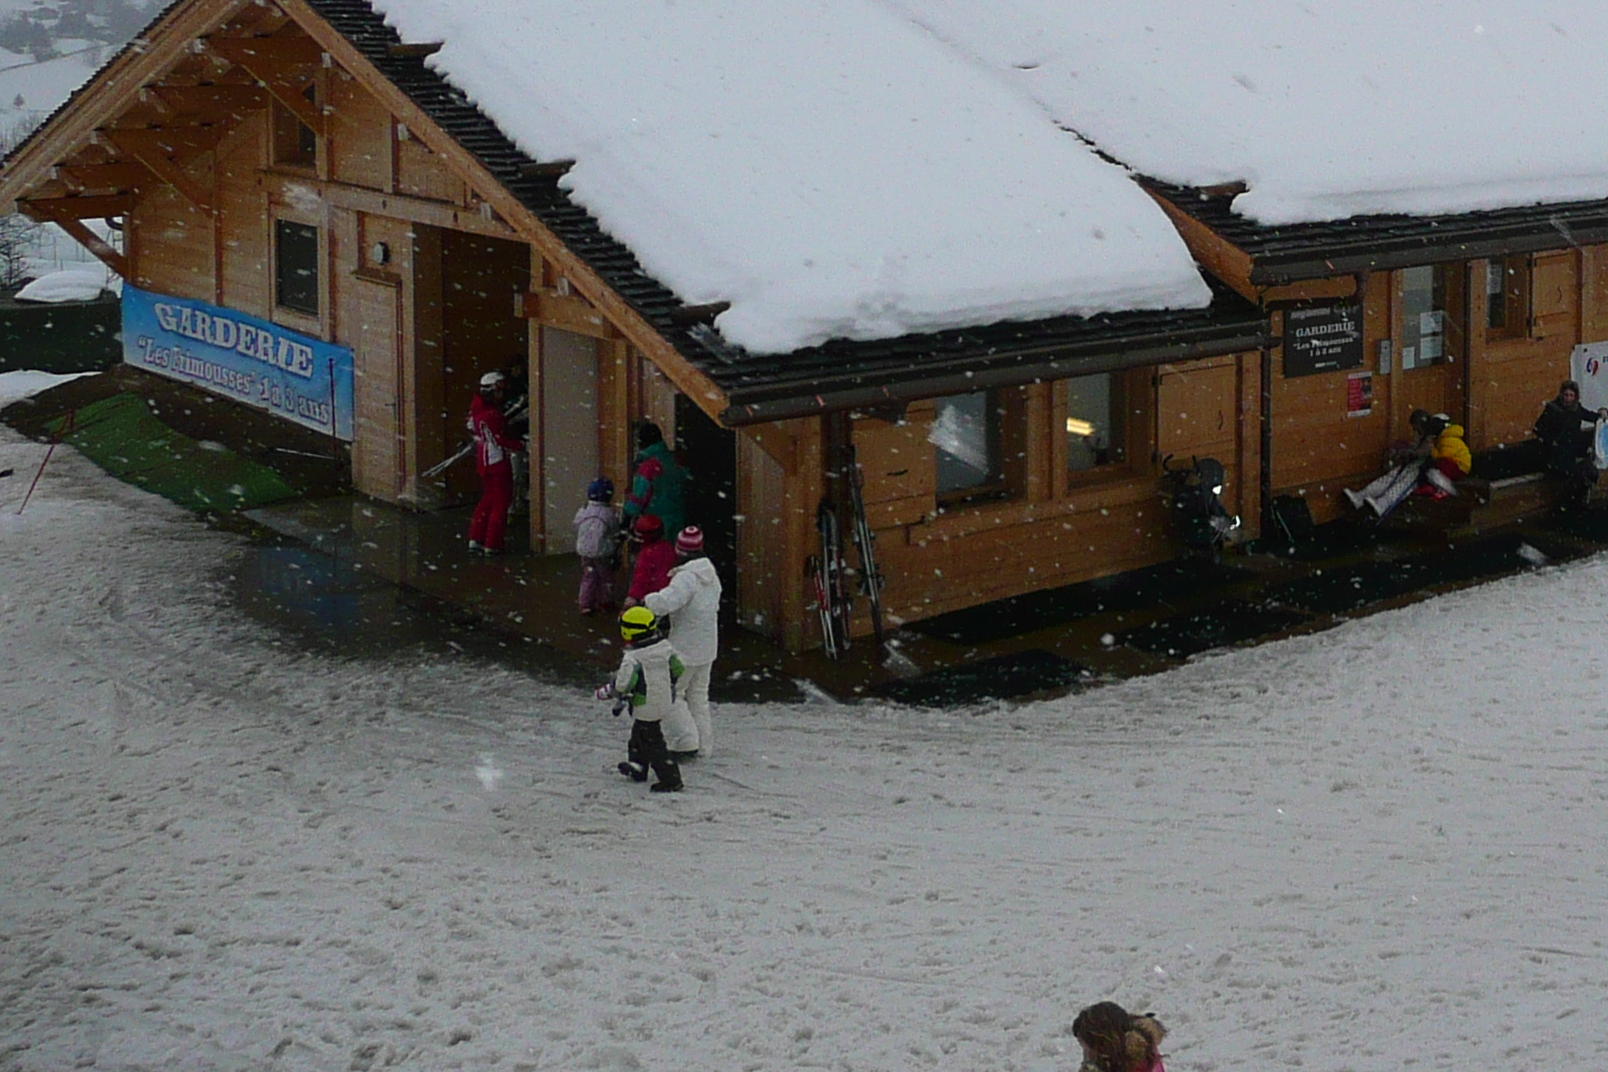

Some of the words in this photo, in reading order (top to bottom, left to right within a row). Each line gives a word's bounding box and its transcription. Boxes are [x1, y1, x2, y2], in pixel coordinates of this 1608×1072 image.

[154, 302, 314, 378] GARDERIE
[1295, 321, 1356, 338] GARDERIE
[285, 387, 296, 412] 3
[297, 396, 332, 425] ans
